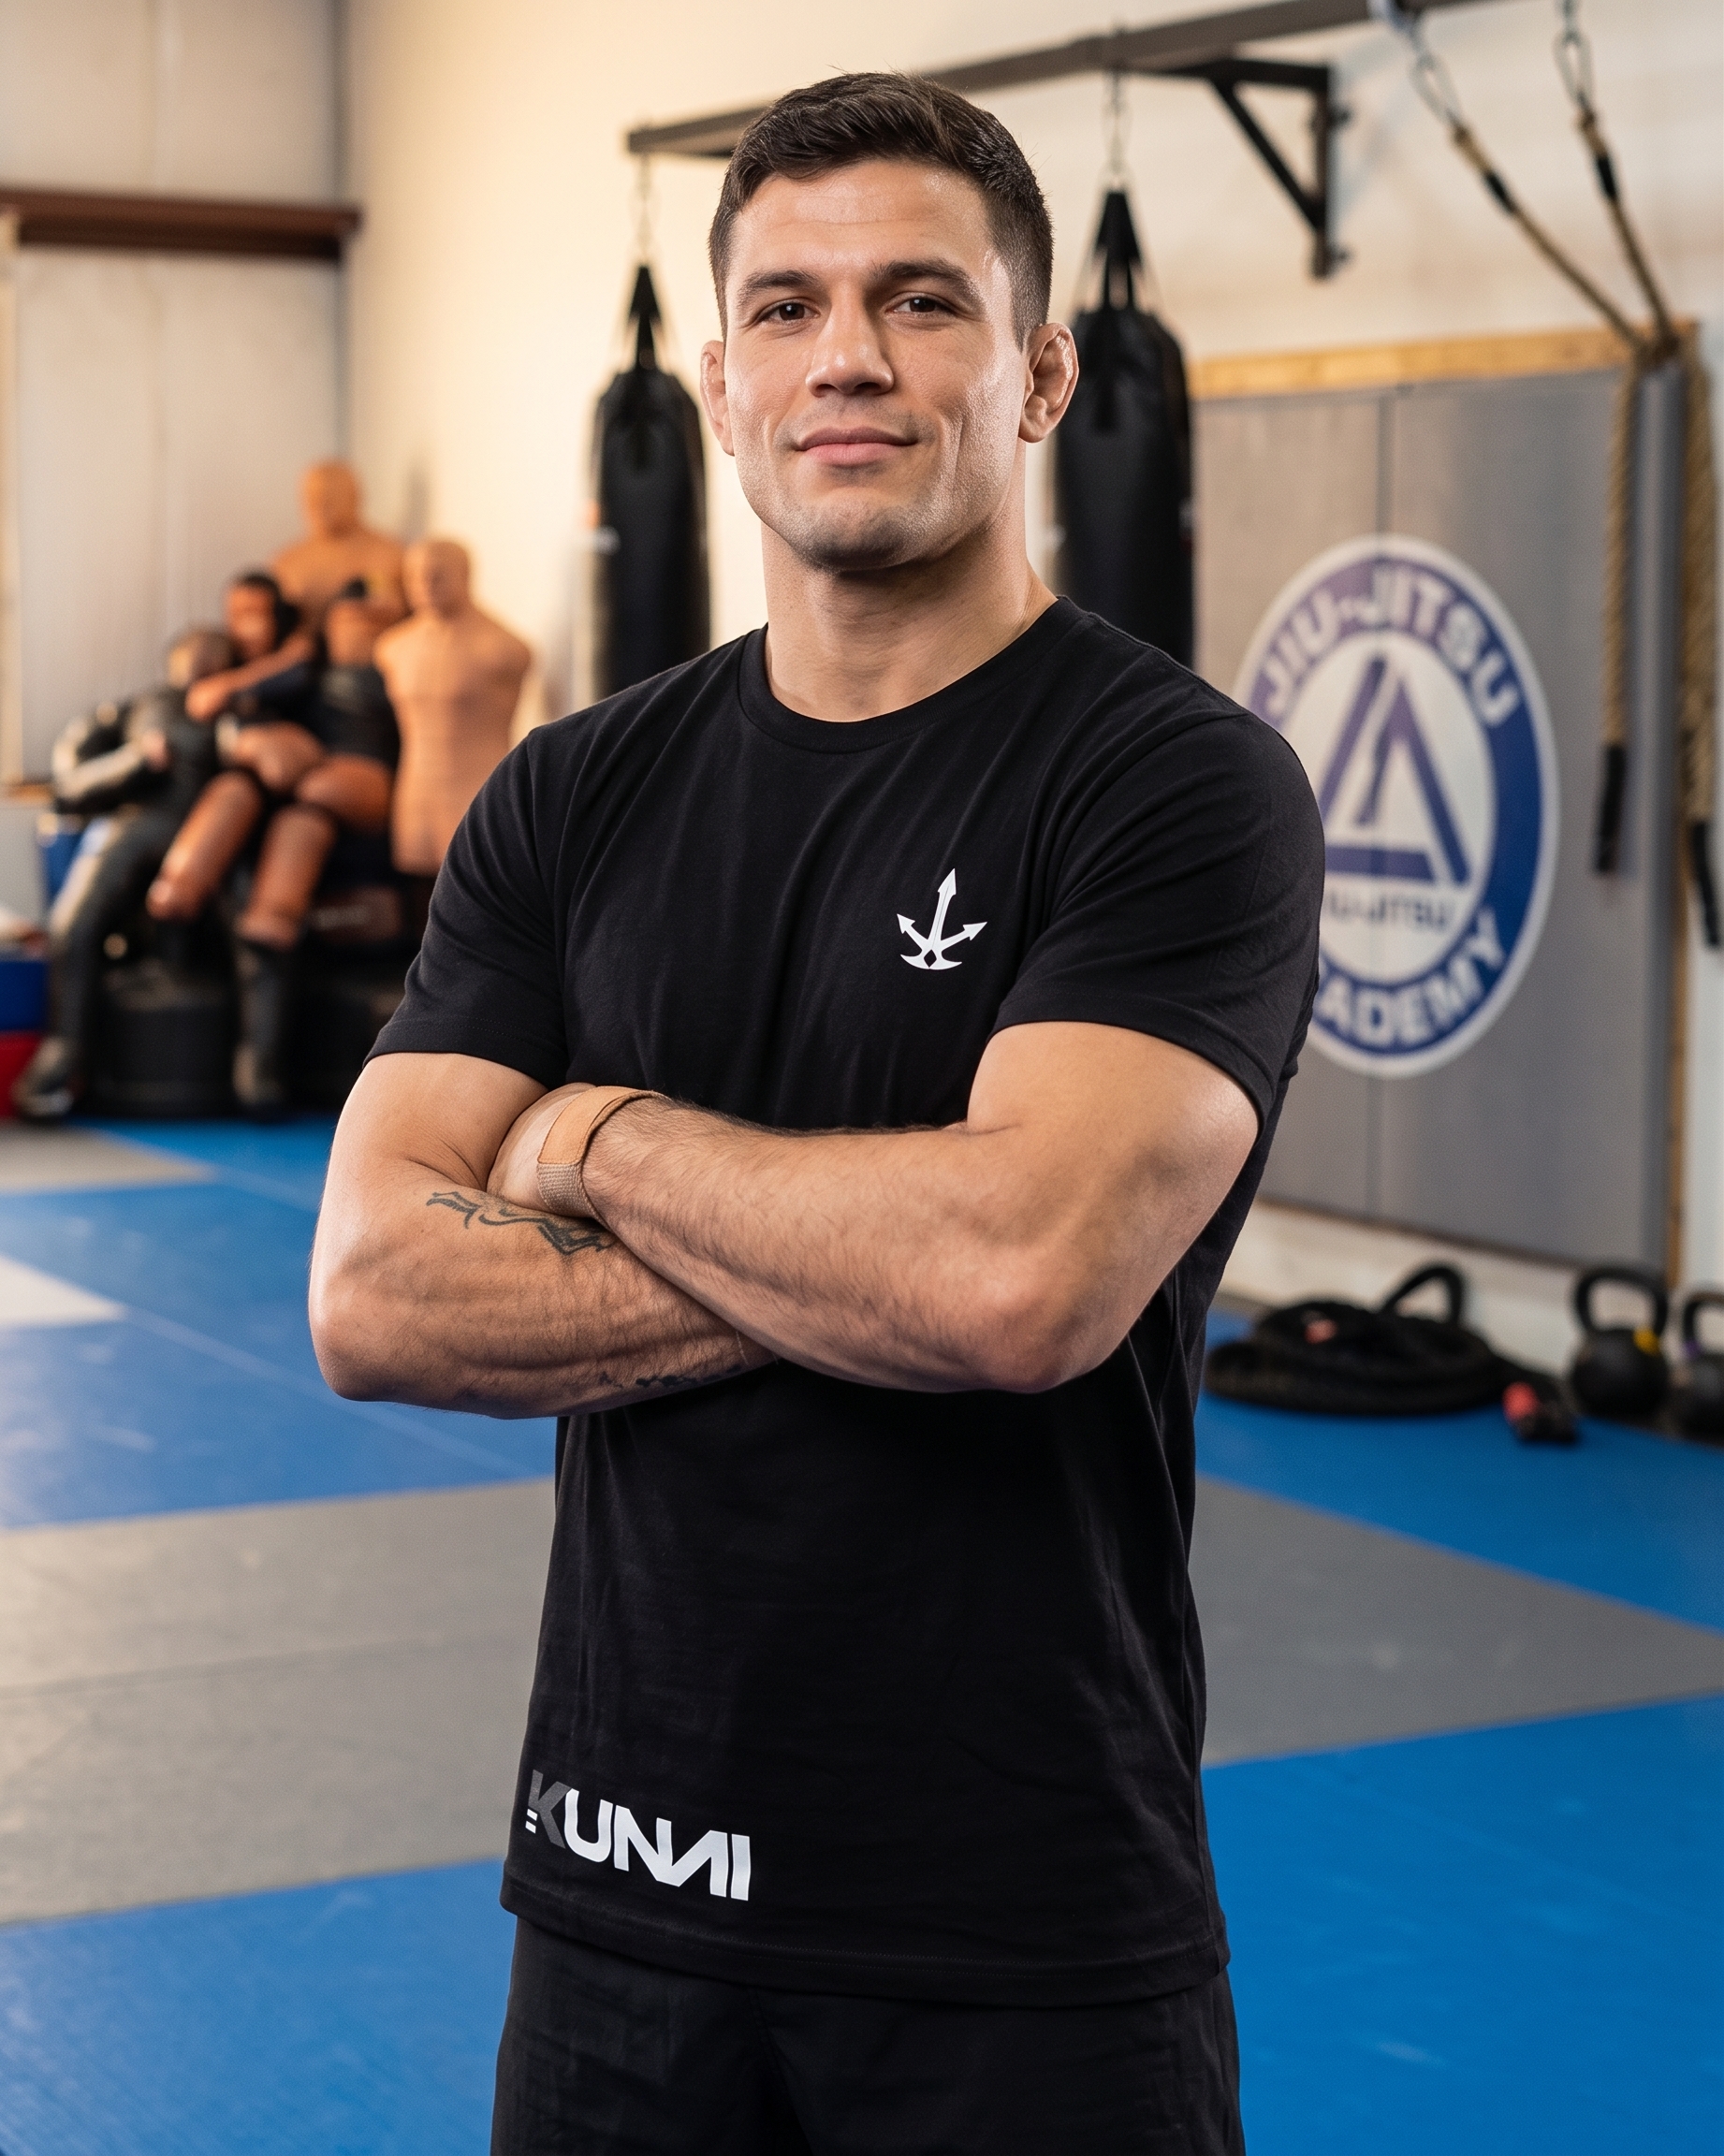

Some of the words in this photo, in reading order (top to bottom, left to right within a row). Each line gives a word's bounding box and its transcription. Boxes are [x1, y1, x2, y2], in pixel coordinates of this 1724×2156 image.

[1264, 567, 1519, 724] JIU-JITSU
[1315, 905, 1504, 1045] ADEMY
[1329, 892, 1447, 928] U-JITSU
[525, 1769, 751, 1901] KUNAI
